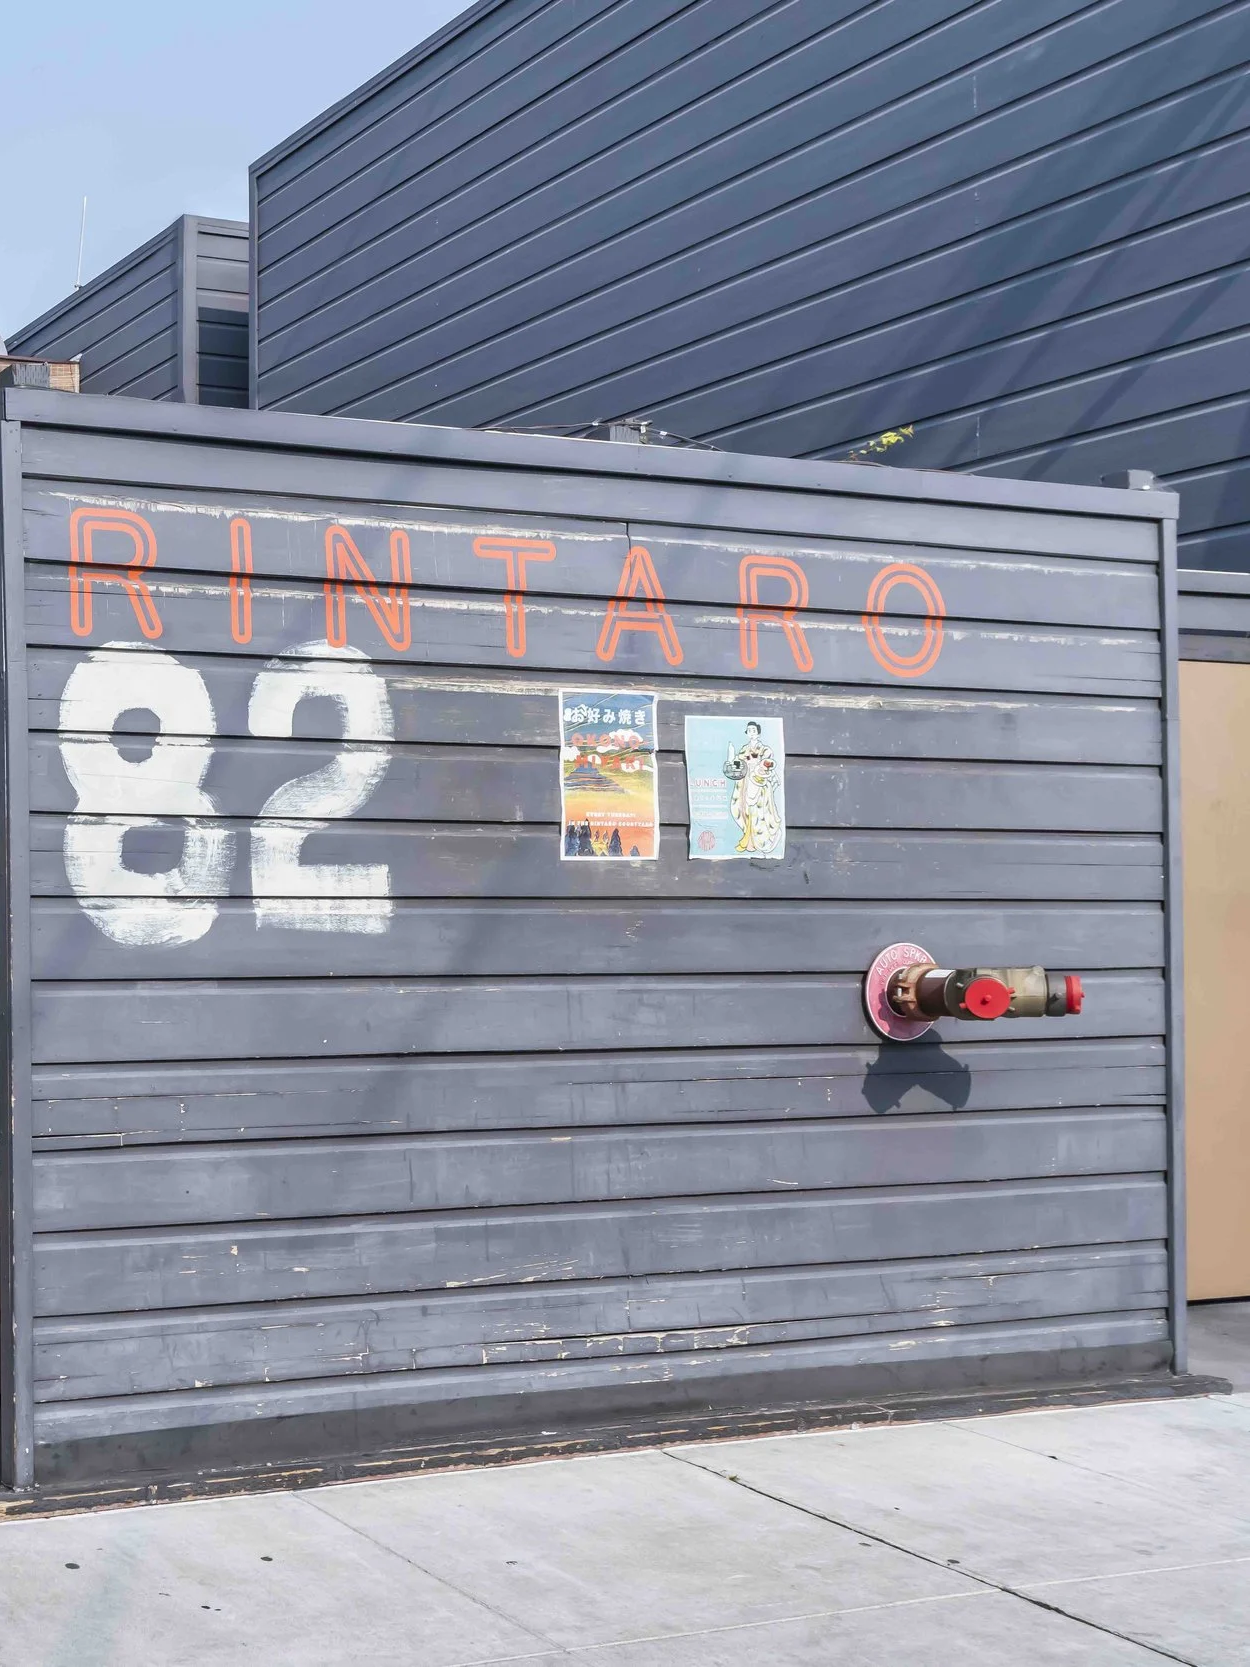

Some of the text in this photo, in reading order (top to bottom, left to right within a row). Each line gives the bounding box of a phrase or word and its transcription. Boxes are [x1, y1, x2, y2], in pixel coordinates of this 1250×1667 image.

[69, 506, 948, 680] RINTARO
[58, 640, 396, 948] 82
[574, 754, 645, 771] MIYAKI
[876, 950, 898, 975] AUTO
[903, 947, 927, 963] SPKR
